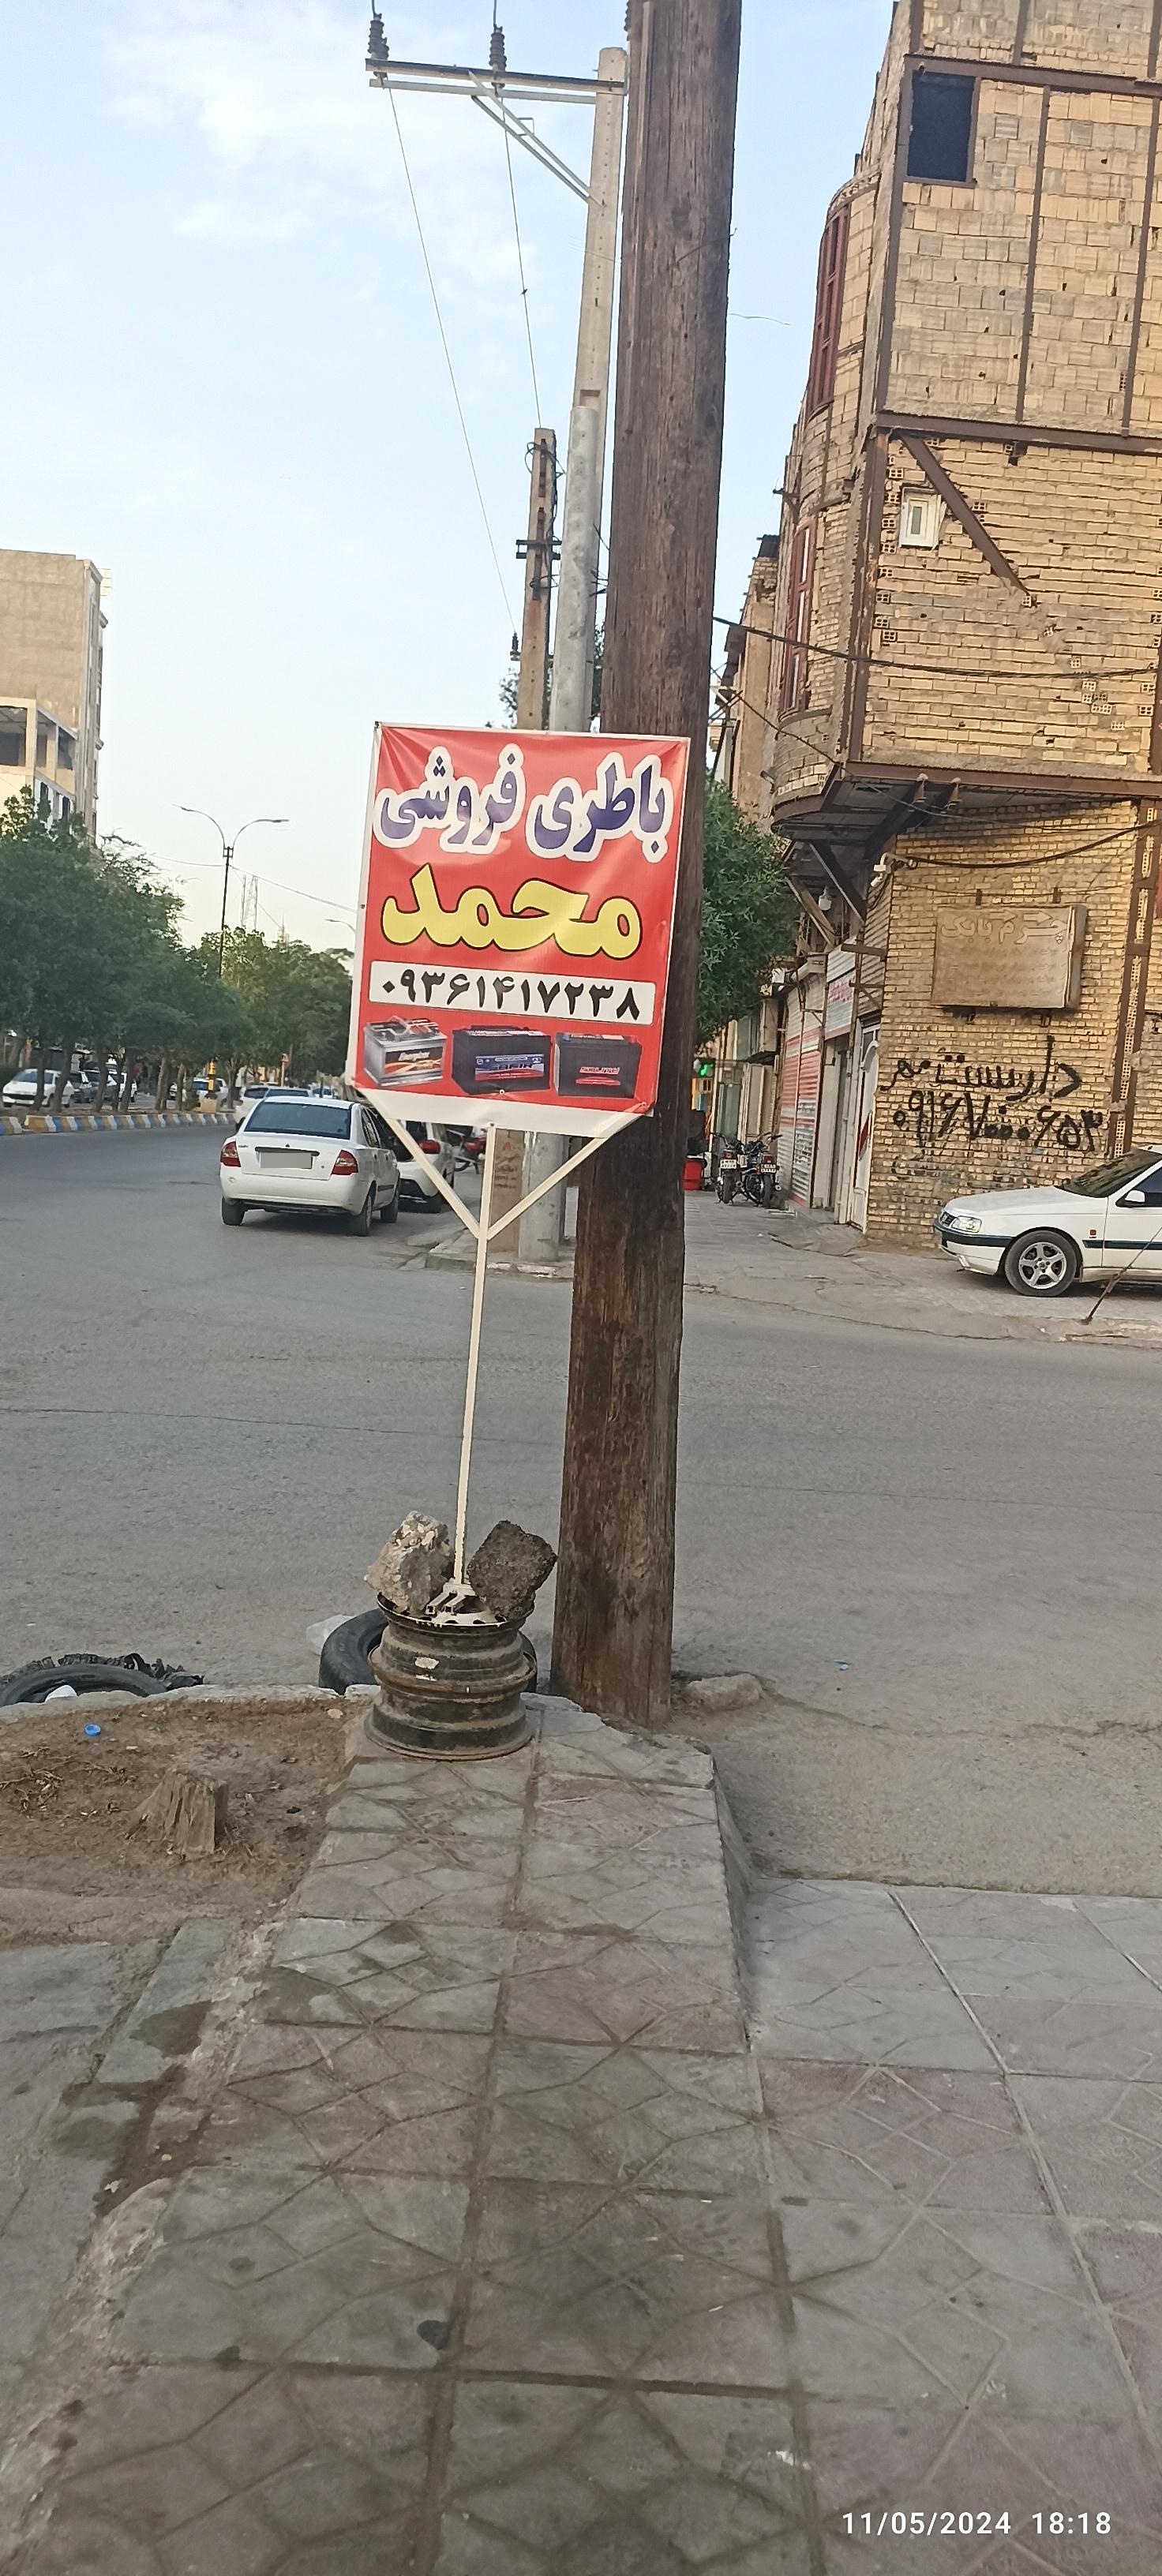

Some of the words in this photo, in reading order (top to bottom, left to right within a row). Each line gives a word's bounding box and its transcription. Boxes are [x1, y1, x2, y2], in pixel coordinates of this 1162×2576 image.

[379, 752, 519, 847] فروشی
[533, 760, 666, 855] باطری
[380, 863, 643, 960] محمد
[382, 968, 640, 1020] ۰۹۳۶۱۴۱۷۲۳۸
